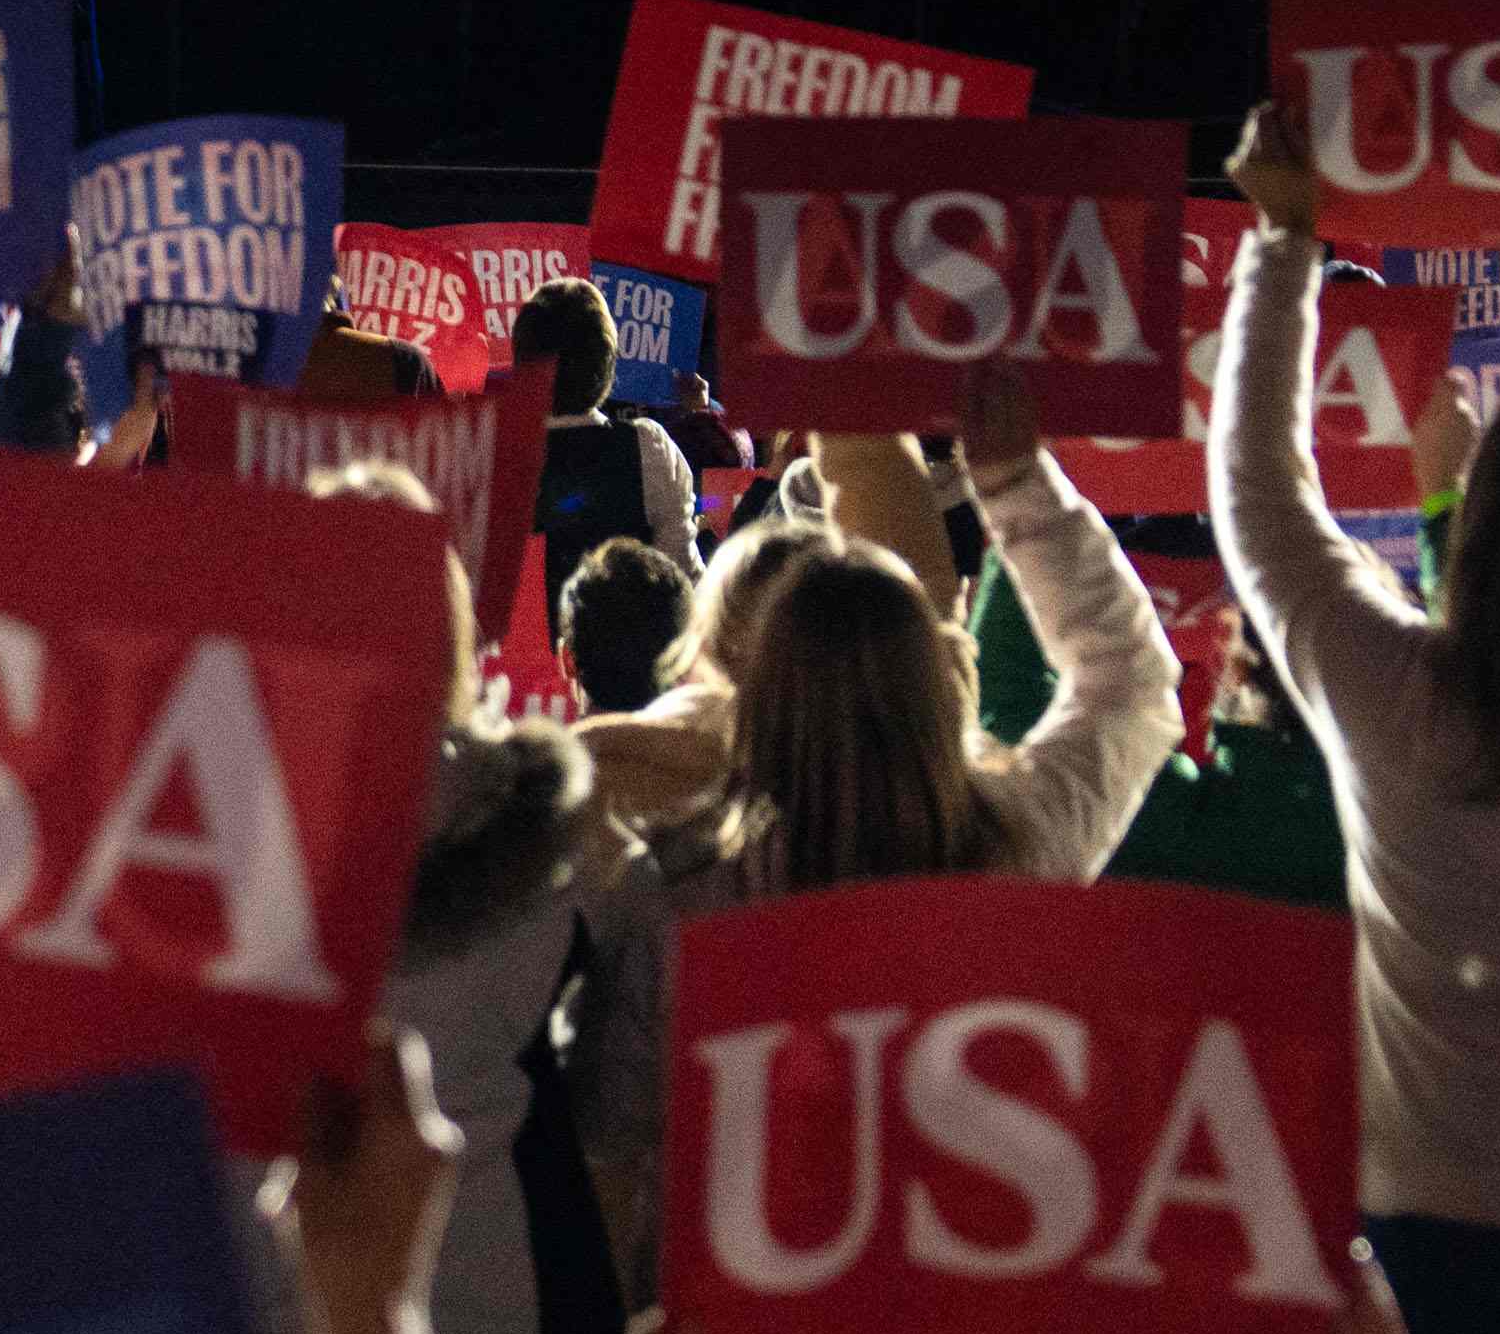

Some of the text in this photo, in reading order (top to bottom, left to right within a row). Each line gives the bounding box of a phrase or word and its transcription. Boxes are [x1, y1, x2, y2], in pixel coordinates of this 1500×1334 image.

[202, 139, 304, 229] FOR
[340, 250, 467, 327] ARRIS
[614, 278, 675, 328] FOR
[738, 190, 1158, 364] USA
[350, 312, 432, 355] ALZ
[692, 997, 1348, 1312] USA
